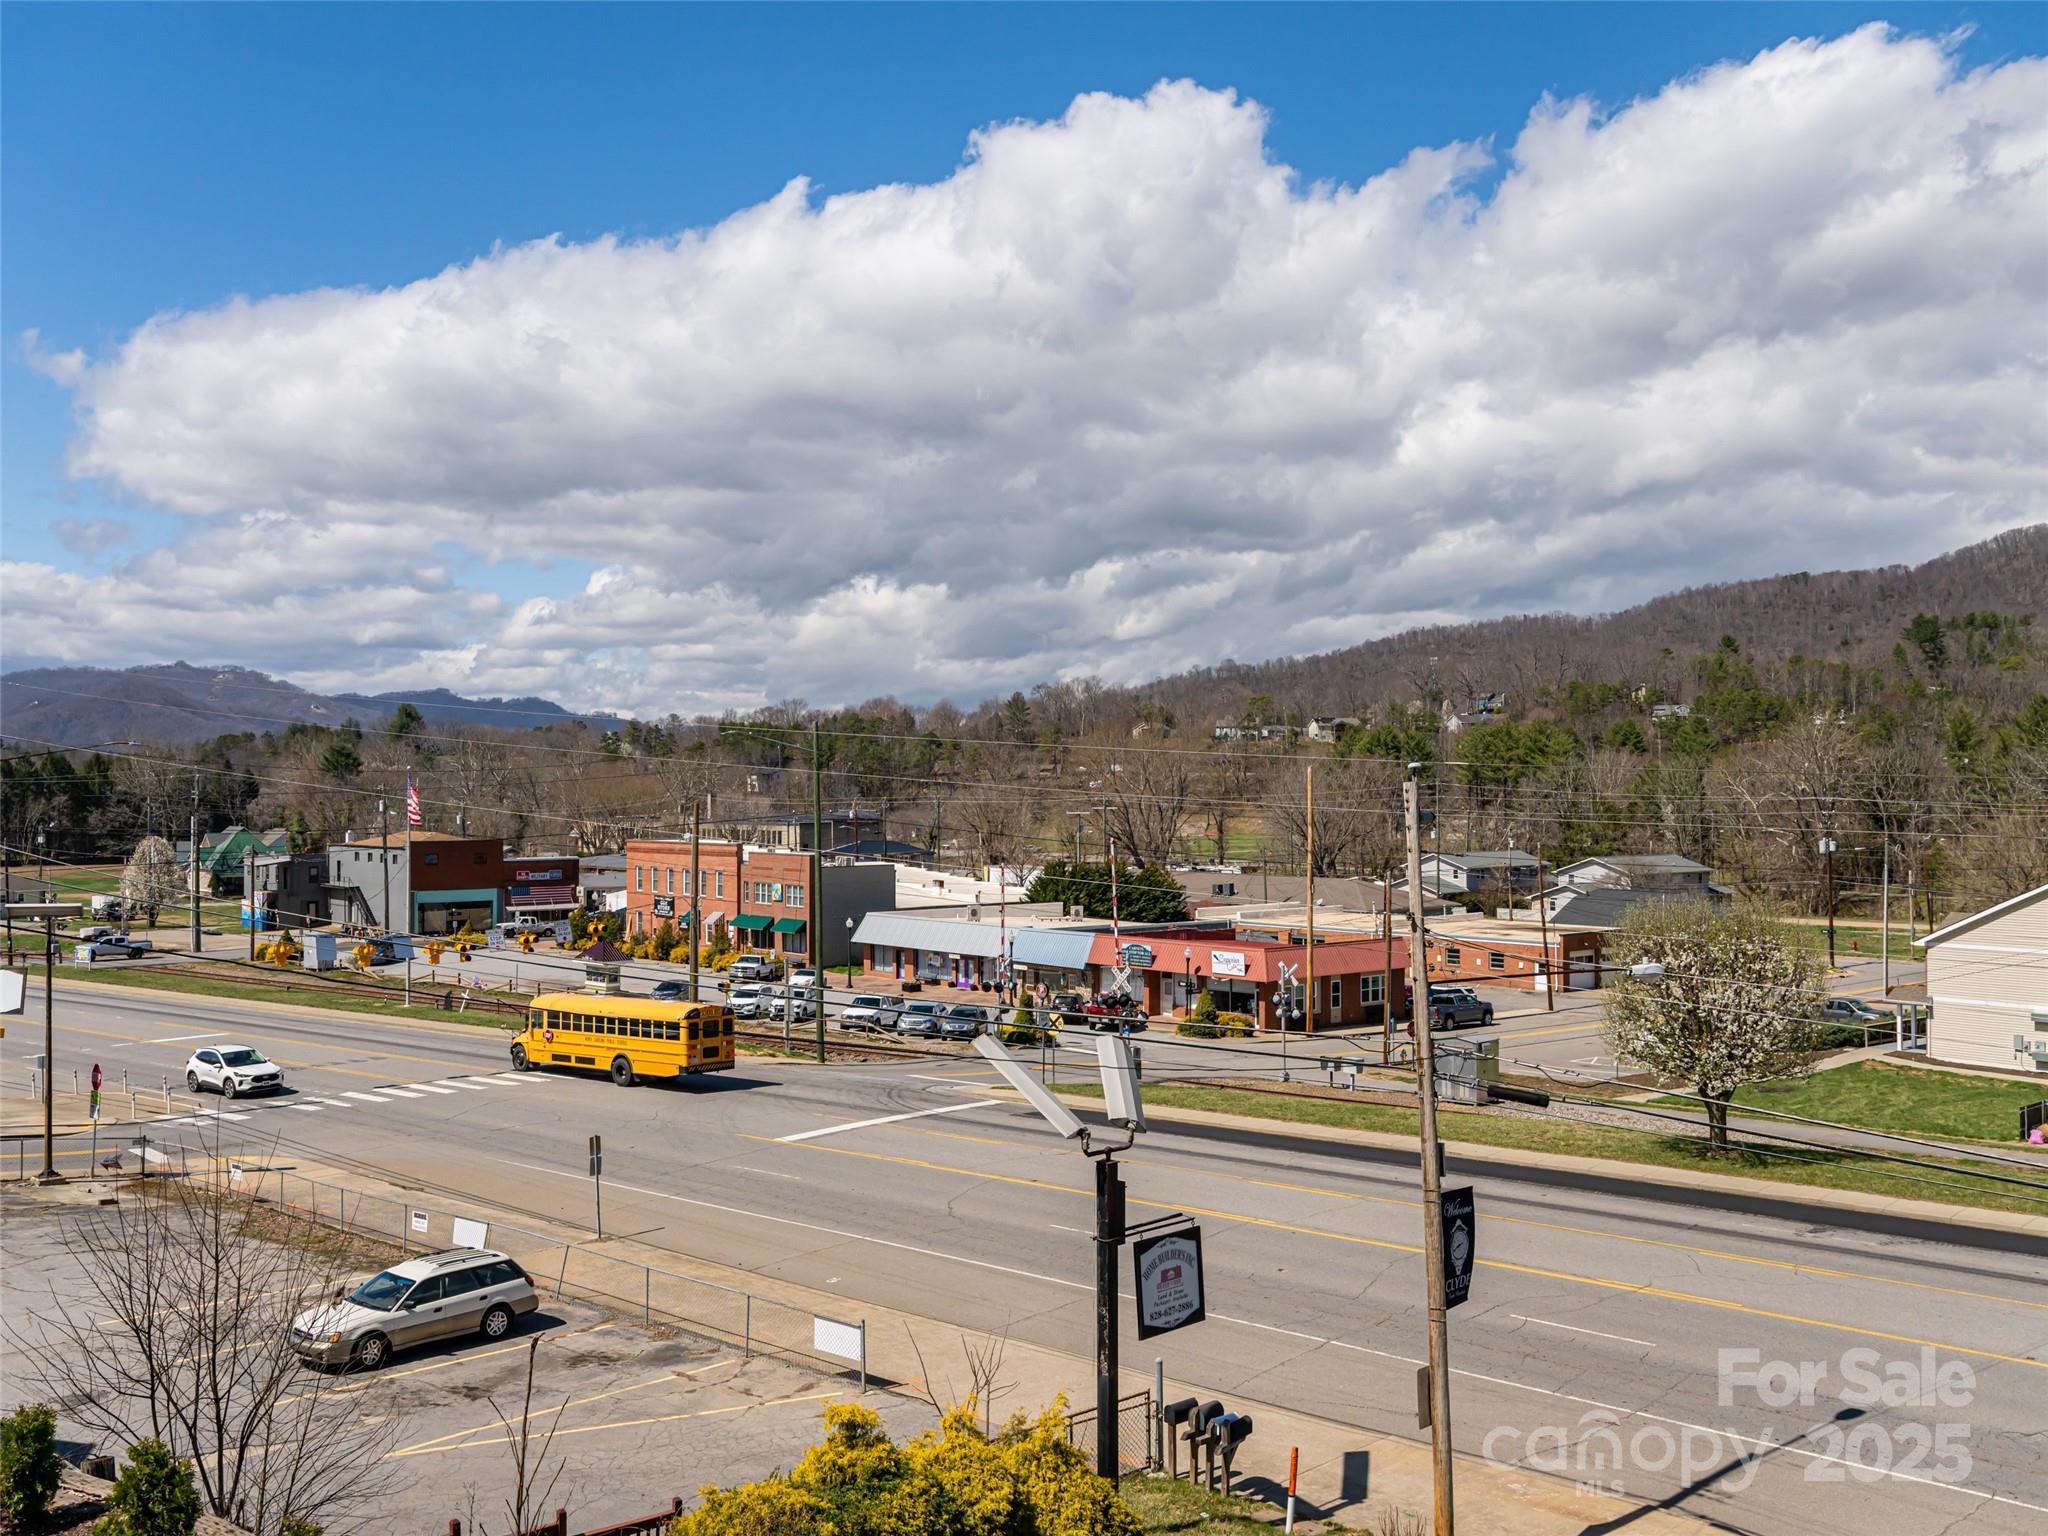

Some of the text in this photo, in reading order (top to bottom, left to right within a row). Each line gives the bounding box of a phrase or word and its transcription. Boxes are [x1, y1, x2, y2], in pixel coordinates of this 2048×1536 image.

[1443, 1198, 1472, 1217] Welcome
[1143, 1257, 1158, 1281] HOME
[1445, 1273, 1471, 1292] CLYDE
